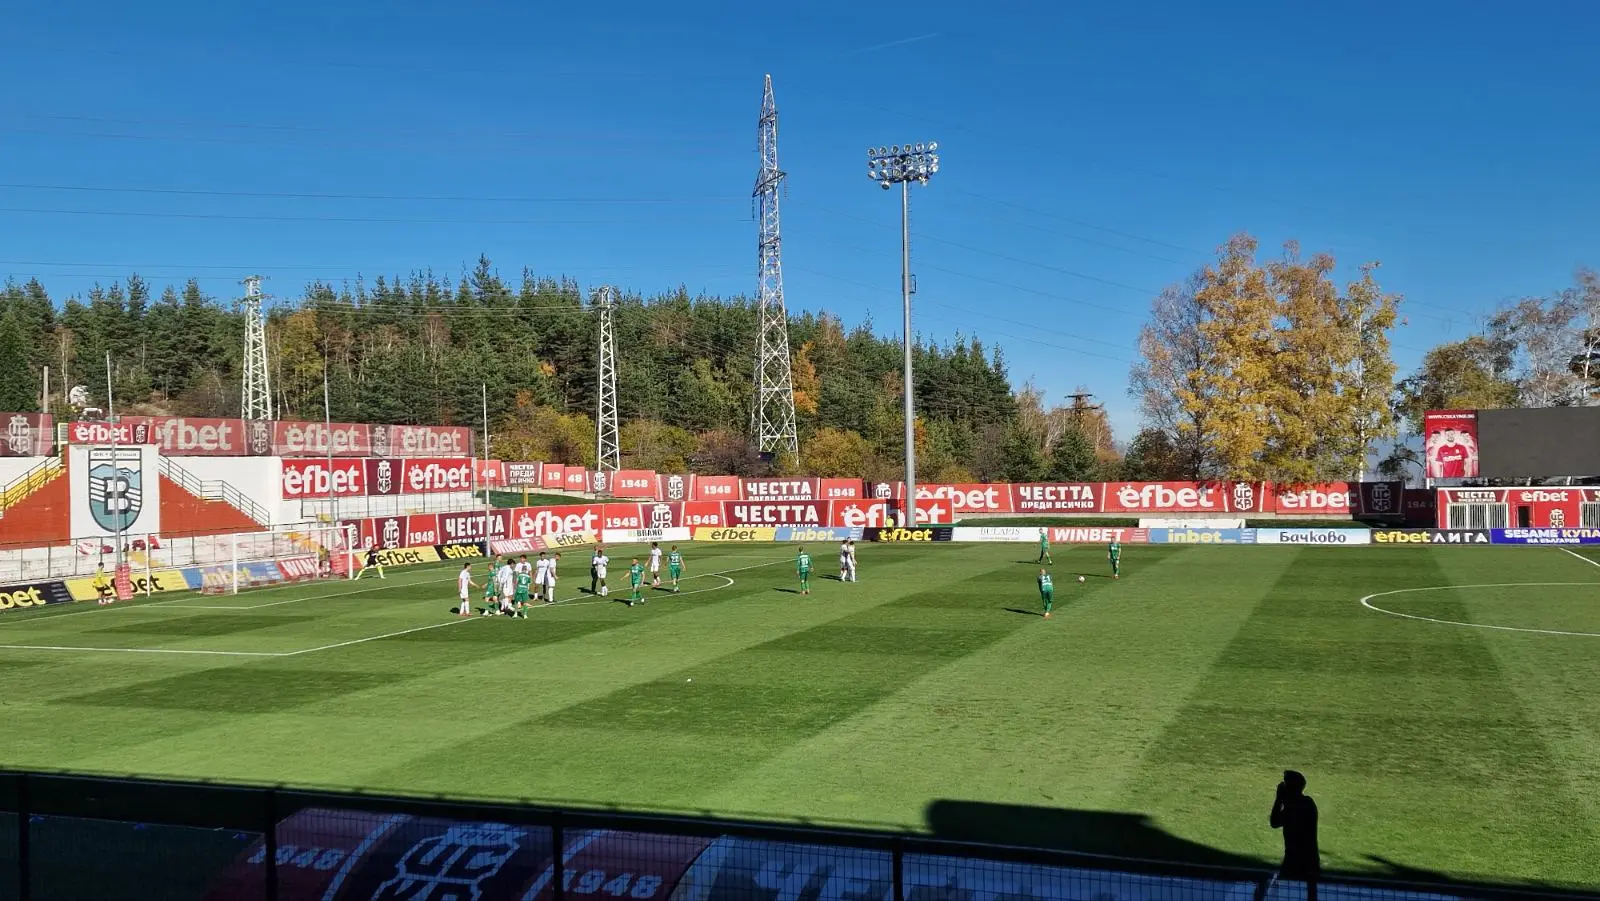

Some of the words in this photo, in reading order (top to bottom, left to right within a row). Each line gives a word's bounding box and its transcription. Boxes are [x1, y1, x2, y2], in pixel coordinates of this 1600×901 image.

[283, 465, 360, 495] efbet
[409, 463, 470, 490] efbet
[548, 471, 561, 480] 19
[567, 474, 583, 483] 48
[621, 480, 649, 488] 1948
[704, 486, 732, 494] 1948
[747, 482, 811, 495] ЧЕСТТА
[828, 488, 856, 497] 1948
[1020, 486, 1094, 499] ЧЕСТТА
[1119, 485, 1214, 508] efbet
[1282, 489, 1357, 508] efbet
[1021, 501, 1052, 509] ПРЕДИ
[685, 515, 719, 525] 1948
[734, 505, 819, 522] ЧЕСТТА
[446, 515, 504, 537] ЧЕСТТА
[519, 509, 598, 538] efbet
[606, 517, 638, 527] 1948
[409, 530, 435, 544] 1948
[790, 528, 835, 541] inbet
[1055, 529, 1125, 541] WINBET
[1168, 529, 1222, 543] inbet
[1279, 531, 1346, 543] Бачково
[1504, 529, 1559, 538] SESAME
[1562, 529, 1600, 538] КУПА
[492, 538, 534, 554] WINBET
[561, 868, 663, 899] 1948
